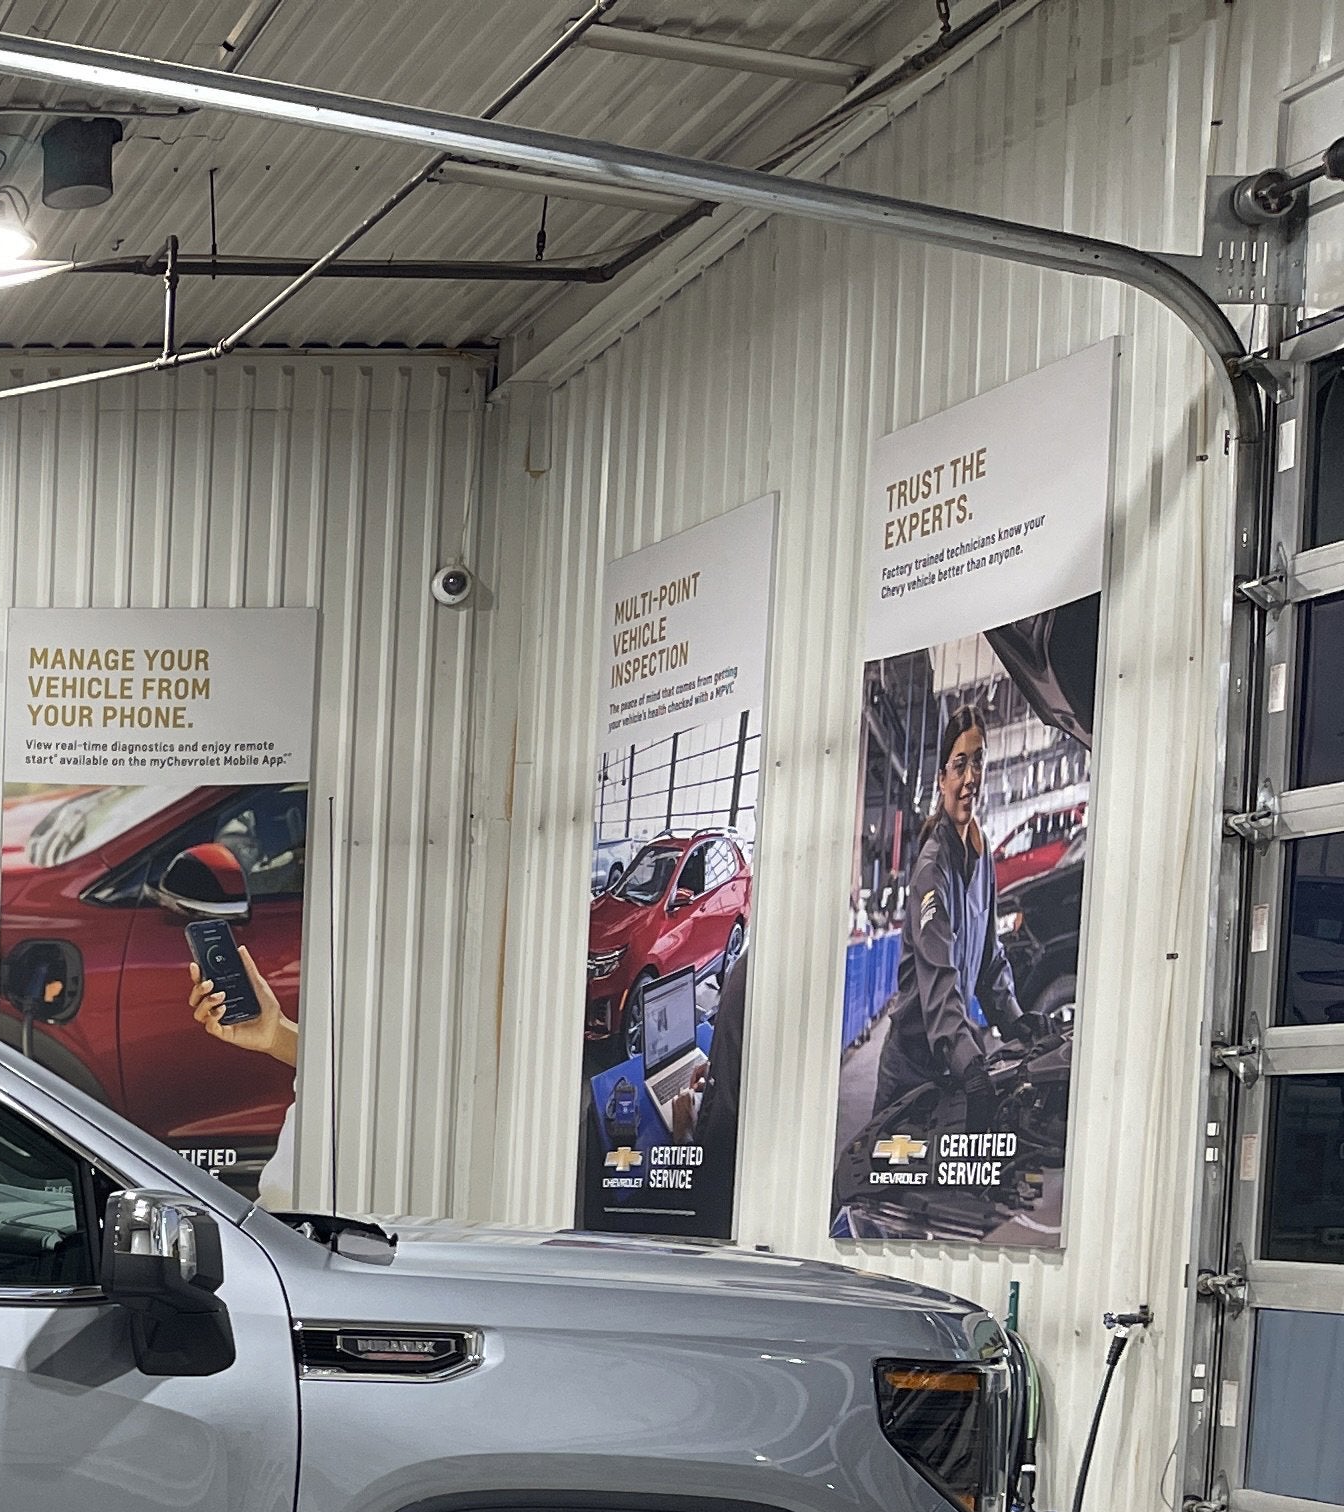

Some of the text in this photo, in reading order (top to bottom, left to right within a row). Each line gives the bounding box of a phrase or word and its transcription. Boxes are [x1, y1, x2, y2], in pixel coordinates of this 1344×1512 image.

[886, 447, 988, 513] TRUST THE
[884, 493, 973, 550] EXPERTS.
[882, 513, 1046, 581] Factory trained technicians know your
[881, 544, 1024, 599] Chevy vehicle better than anyone.
[614, 571, 701, 626] MULTI-POINT
[612, 616, 667, 657] VEHICLE
[29, 647, 209, 671] MANAGE YOUR
[611, 641, 690, 690] INSPECTION
[28, 676, 211, 700] VEHICLE FROM
[609, 703, 620, 716] The
[638, 694, 646, 706] of
[646, 688, 661, 703] mind
[662, 685, 675, 699] that
[676, 681, 696, 695] comes
[697, 674, 713, 688] from
[26, 704, 194, 729] YOUR PHONE.
[608, 719, 622, 734] your
[25, 739, 274, 756] View real-time diagnostics and enjoy remote
[59, 755, 108, 766] available
[112, 757, 125, 766] on
[128, 755, 147, 766] the
[149, 755, 220, 769] myChevrolet
[223, 755, 259, 766] Mobile
[178, 1148, 238, 1166] TIFIED
[651, 1145, 703, 1166] CERTIFIED
[940, 1133, 1018, 1157] CERTIFIED
[602, 1176, 644, 1189] CHEVROLET
[649, 1169, 694, 1190] SERVICE
[869, 1172, 928, 1185] CHEVROLET
[937, 1162, 1001, 1186] SERVICE
